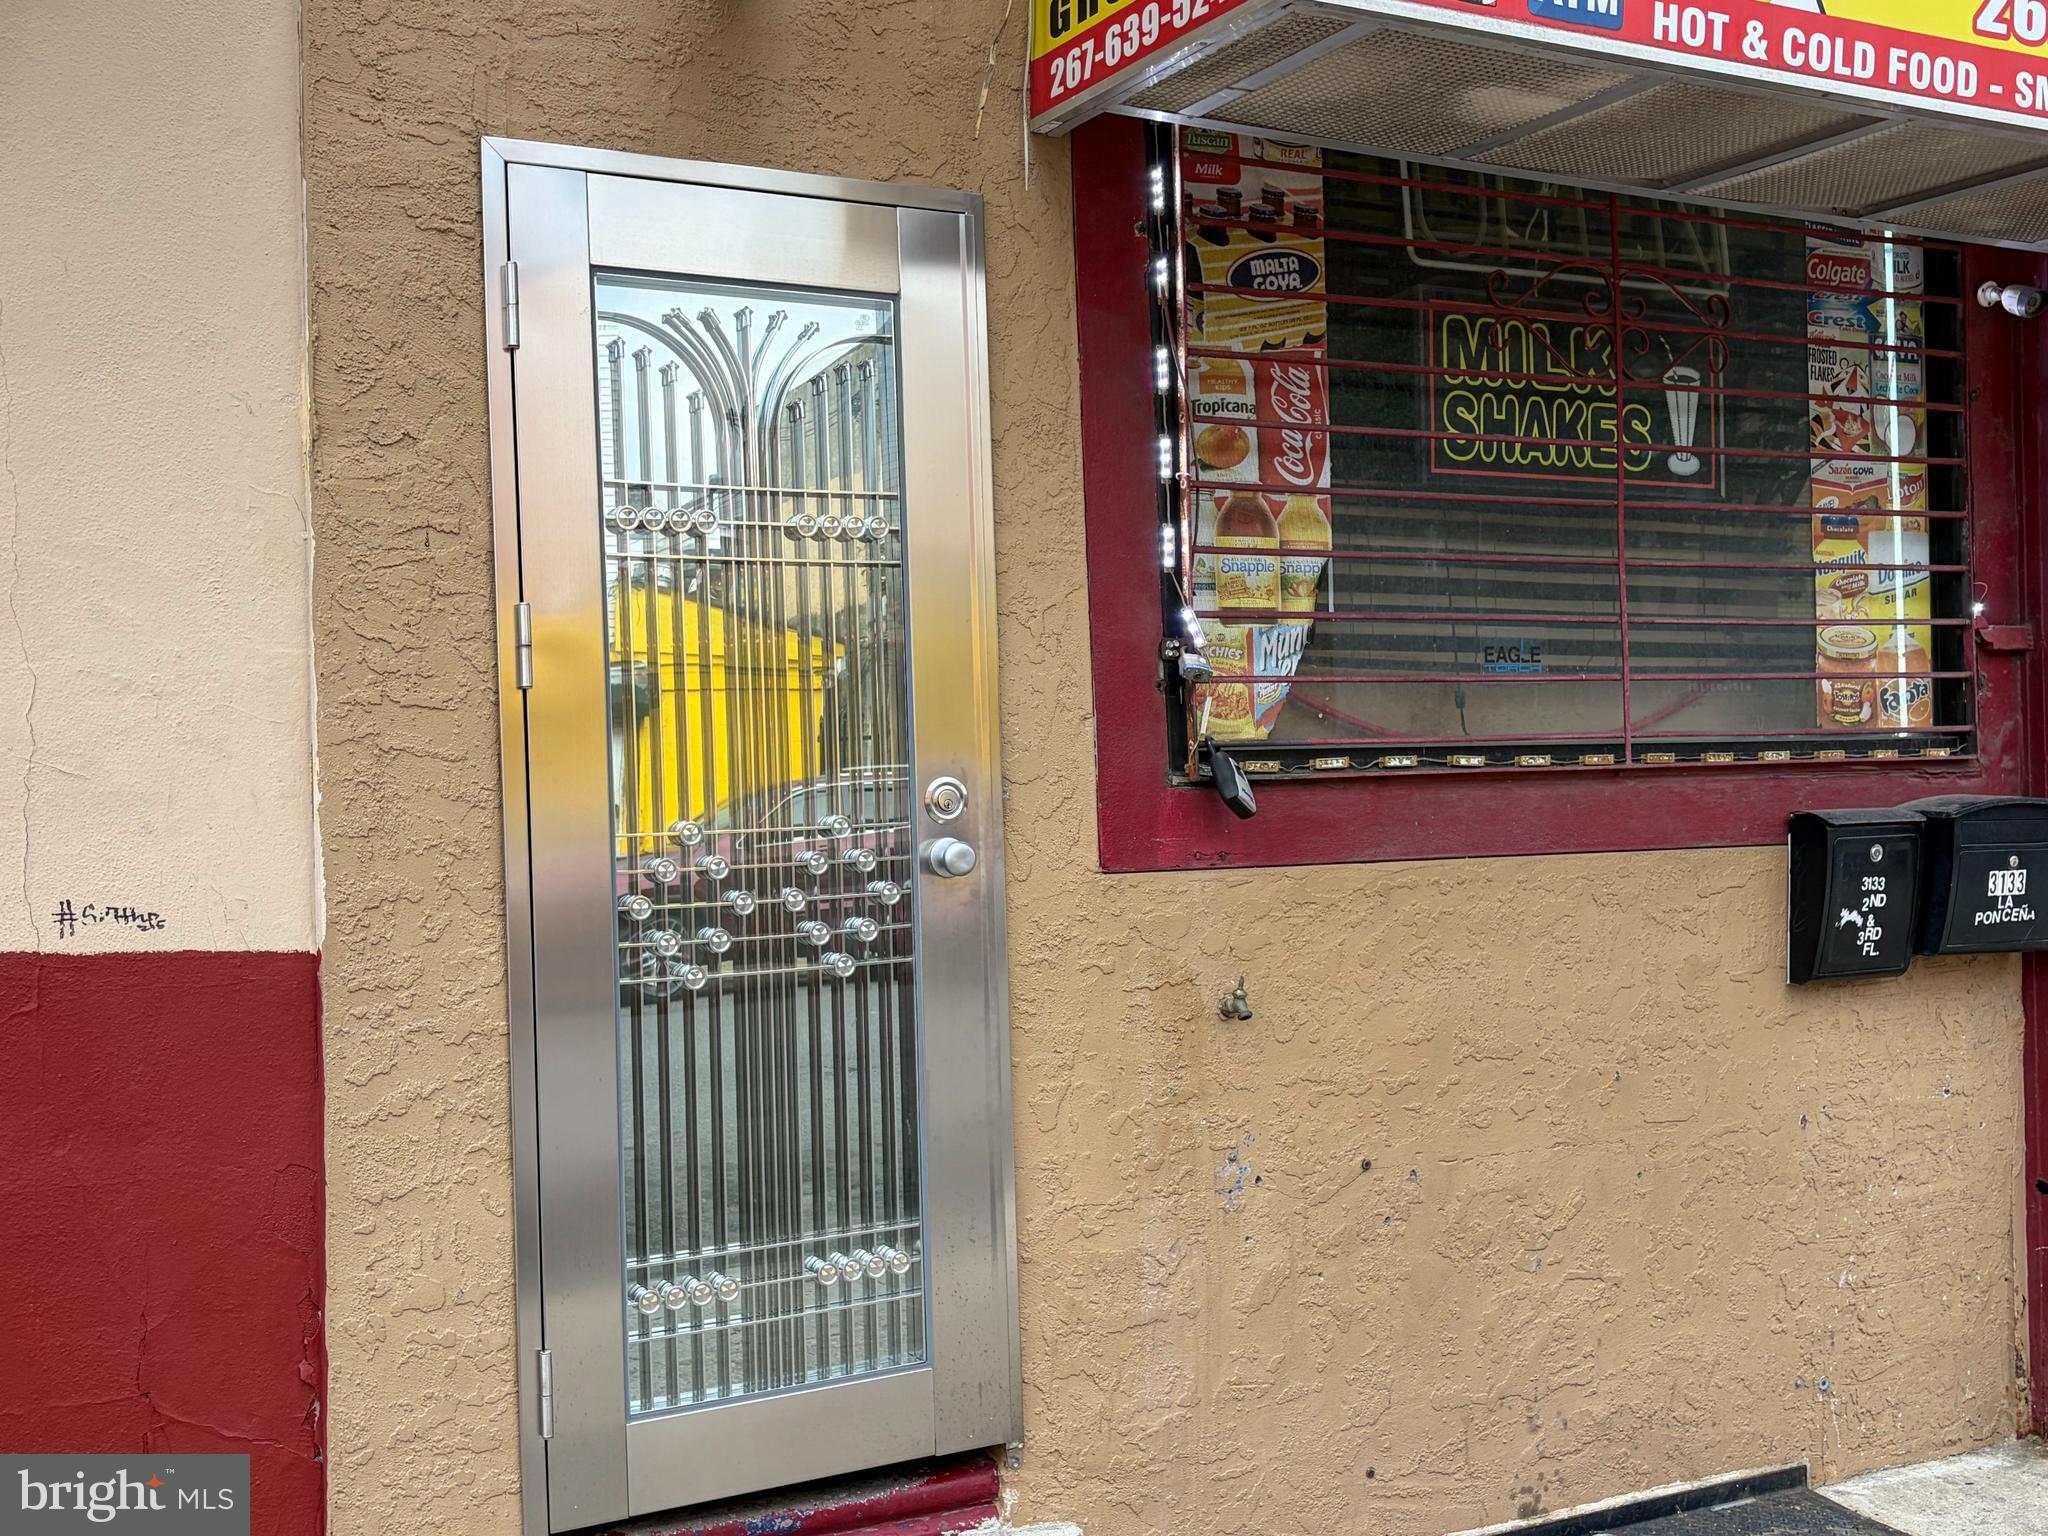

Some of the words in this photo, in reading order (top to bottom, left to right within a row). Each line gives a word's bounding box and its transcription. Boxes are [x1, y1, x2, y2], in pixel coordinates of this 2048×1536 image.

[1653, 1, 1730, 52] HOT
[1742, 20, 1768, 60] &
[1782, 28, 1876, 79] COLD
[1888, 48, 1978, 98] FOOD
[1187, 132, 1229, 147] Tuscan
[1280, 147, 1307, 159] REAL
[1195, 163, 1223, 176] Milk
[1251, 256, 1299, 276] MALTA
[1807, 258, 1866, 286] Colgate
[1253, 274, 1301, 290] GOYA
[1808, 310, 1866, 328] Crest
[1443, 315, 1617, 396] MILK
[1808, 347, 1837, 366] FROSTED
[1874, 338, 1918, 361] GYA
[1810, 365, 1836, 384] FLAKES
[1191, 397, 1256, 415] Tropicana
[1269, 362, 1314, 486] CocaCola
[1443, 390, 1652, 471] SHAKES
[1828, 463, 1852, 476] Sazón
[1852, 466, 1874, 476] GOYA
[1886, 480, 1923, 500] Lton
[1221, 557, 1275, 577] Snapple
[1836, 574, 1865, 586] Chocolate
[1884, 588, 1917, 605] SUAR
[1484, 646, 1541, 663] EAGLE
[1861, 876, 1886, 891] 3133
[1988, 870, 2026, 896] 3133
[1862, 894, 1887, 911] 2ND
[1997, 895, 2014, 909] LA
[1866, 914, 1875, 927] &
[1975, 904, 2035, 926] PONCEÑA
[1857, 927, 1882, 945] 3RD
[1862, 943, 1880, 956] FL.
